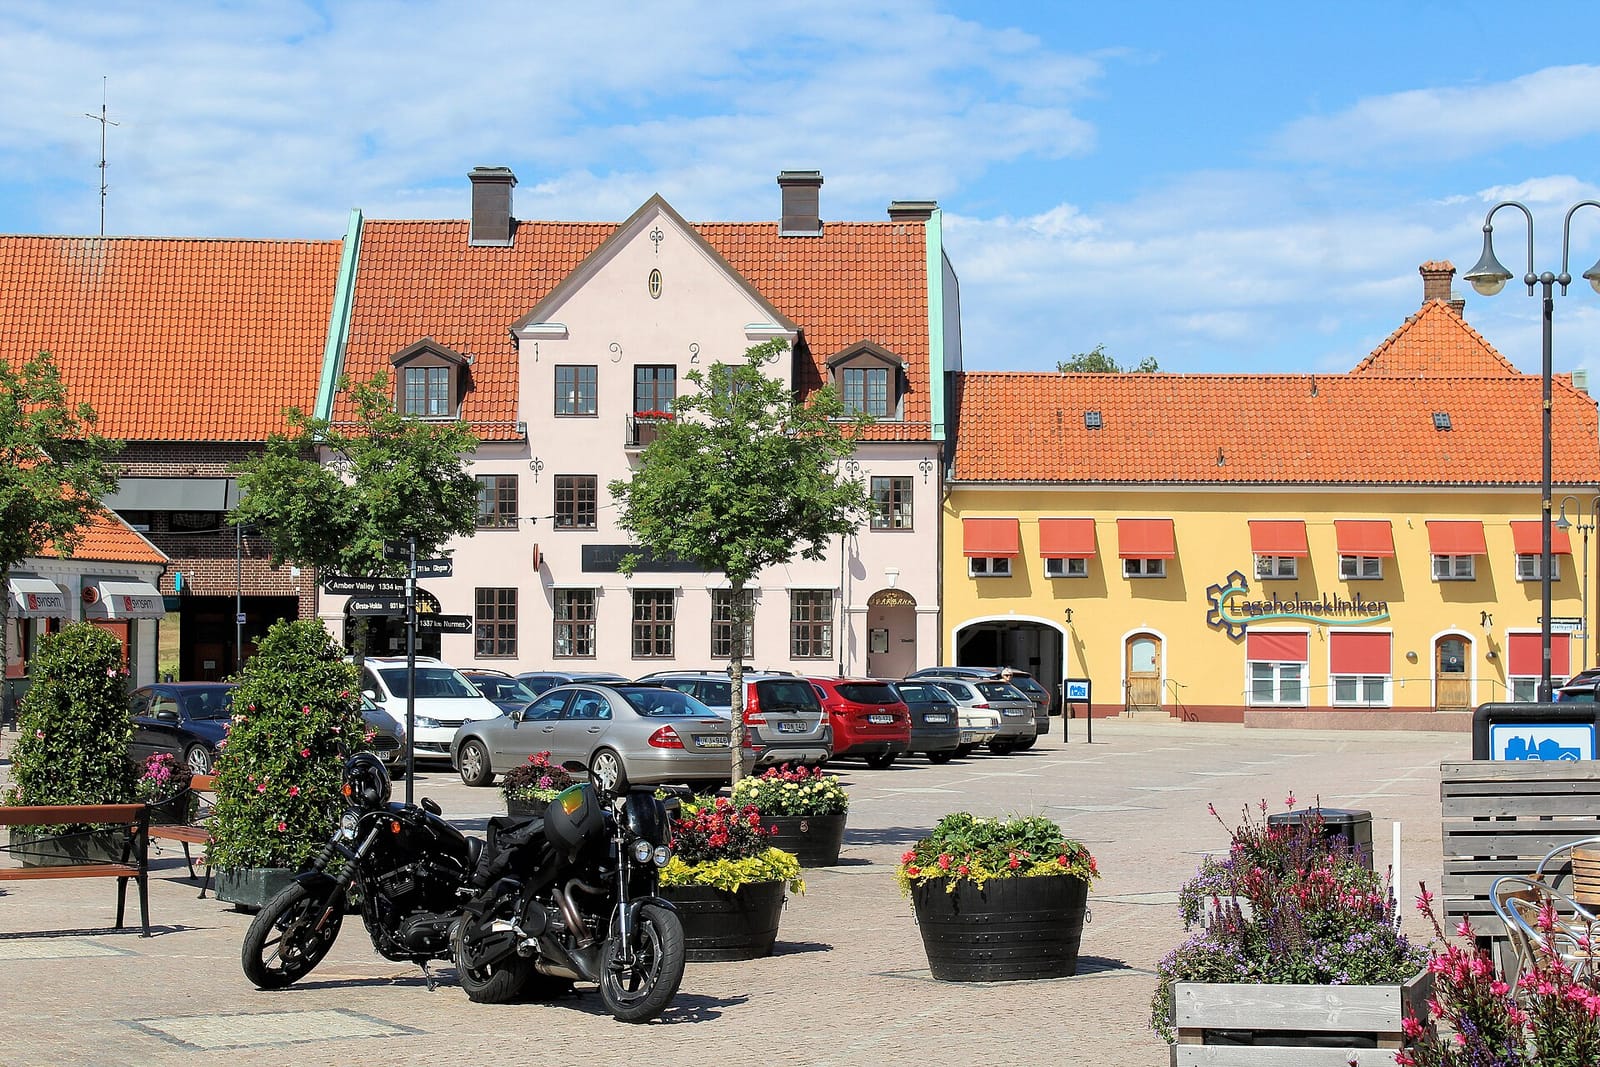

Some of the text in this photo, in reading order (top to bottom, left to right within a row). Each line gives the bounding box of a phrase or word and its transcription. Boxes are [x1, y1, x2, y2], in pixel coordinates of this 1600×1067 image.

[534, 342, 700, 364] 1 9 2
[333, 581, 354, 590] Amber
[356, 582, 375, 592] Valley
[394, 583, 404, 591] km
[1230, 591, 1387, 615] Lagaholmskliniken
[443, 620, 466, 628] Nurmes
